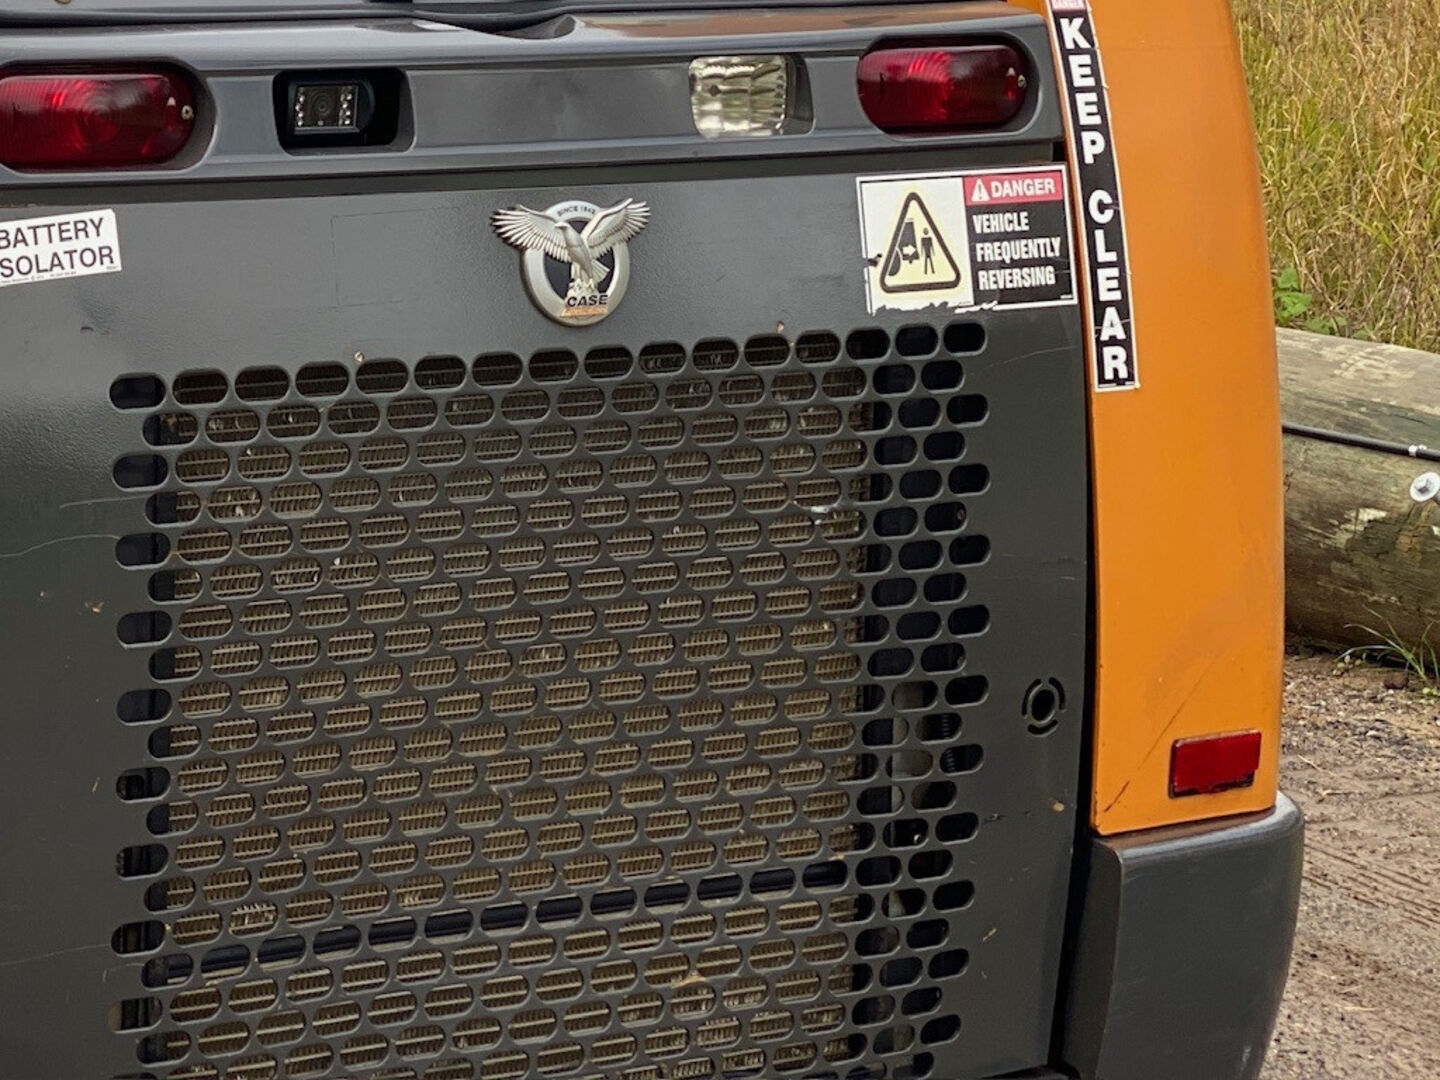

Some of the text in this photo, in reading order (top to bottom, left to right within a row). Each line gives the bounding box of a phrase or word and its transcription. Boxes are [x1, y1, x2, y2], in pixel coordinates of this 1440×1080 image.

[990, 178, 1056, 198] DANGER
[1059, 17, 1129, 381] KEEP CLEAR
[972, 211, 1030, 234] VEHICLE
[975, 236, 1062, 264] FREQUENTLY
[978, 265, 1056, 291] REVERSING
[567, 294, 609, 307] CASE
